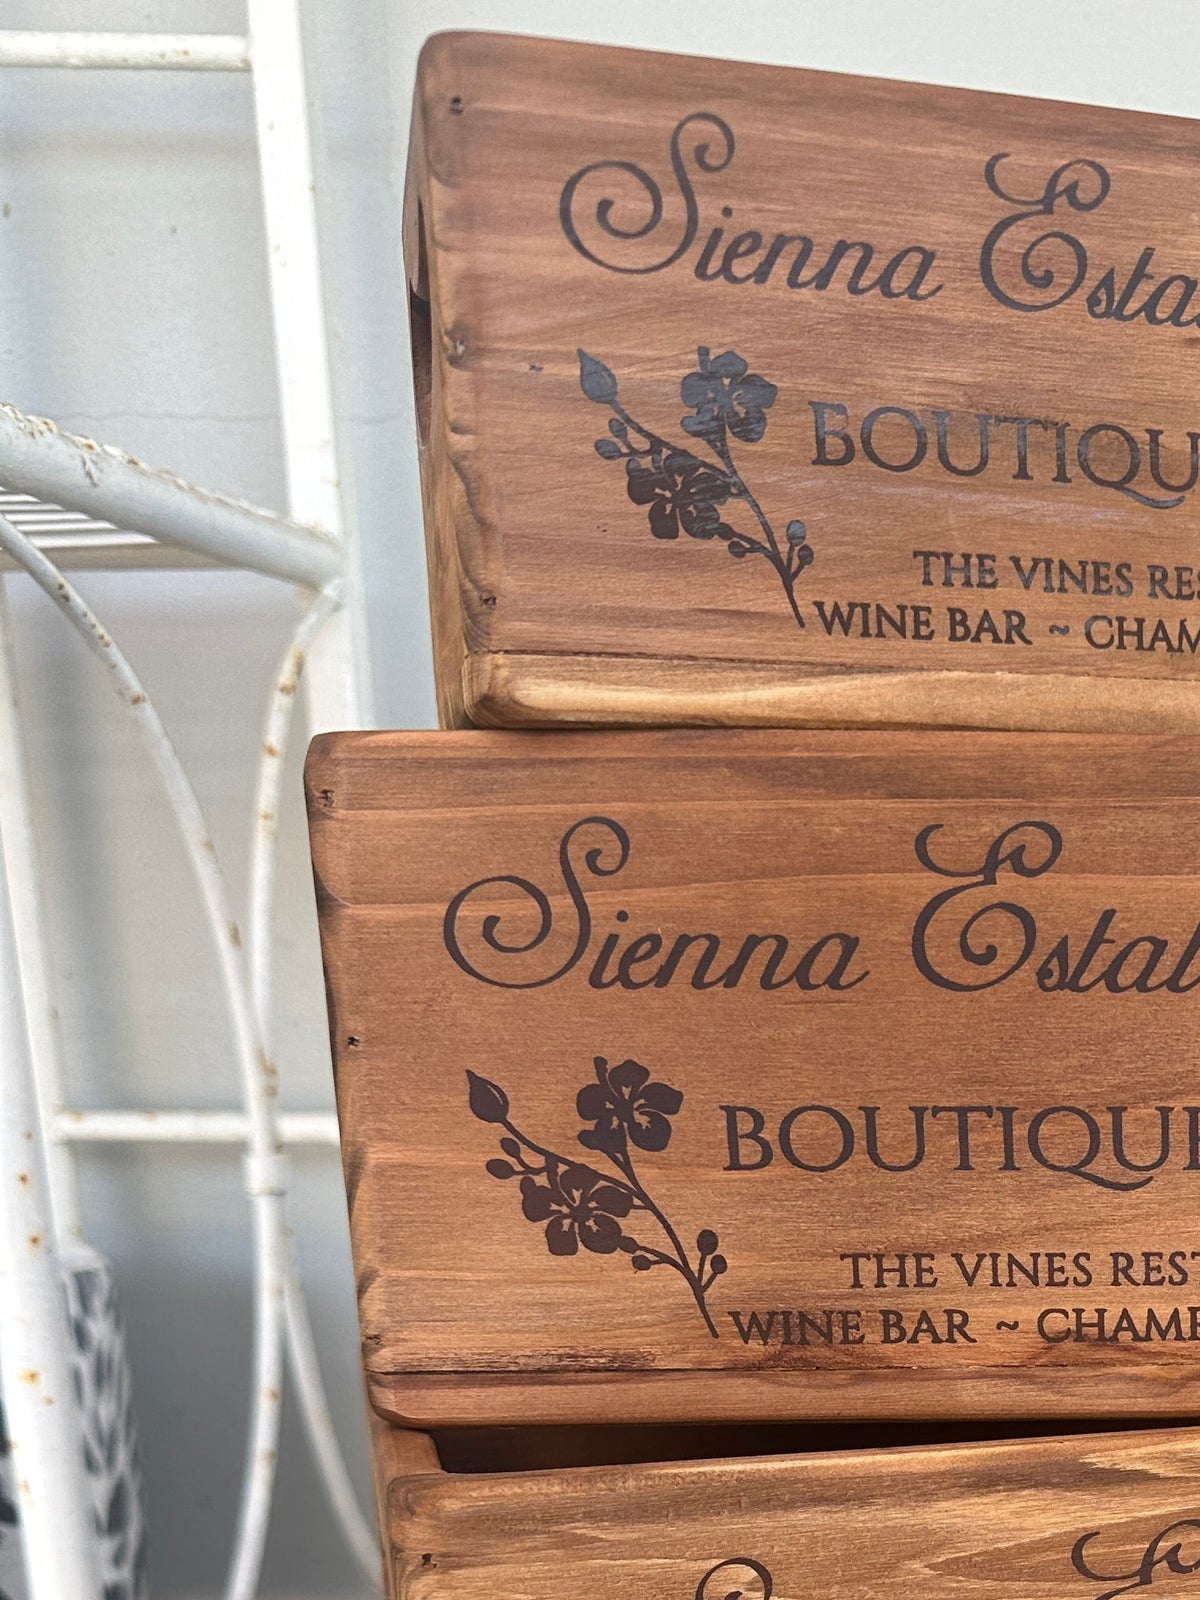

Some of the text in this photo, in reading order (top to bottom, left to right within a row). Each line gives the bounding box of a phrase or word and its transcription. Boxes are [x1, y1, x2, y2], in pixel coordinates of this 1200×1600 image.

[559, 110, 945, 304] Sienna
[912, 549, 999, 590] THE
[1008, 555, 1135, 598] VINES
[813, 598, 939, 645] WINE
[945, 605, 1032, 648] BAR
[442, 815, 871, 994] Sienna
[843, 1250, 940, 1291] THE
[952, 1250, 1094, 1289] VINES
[726, 1306, 871, 1346] WINE
[879, 1307, 978, 1346] BAR
